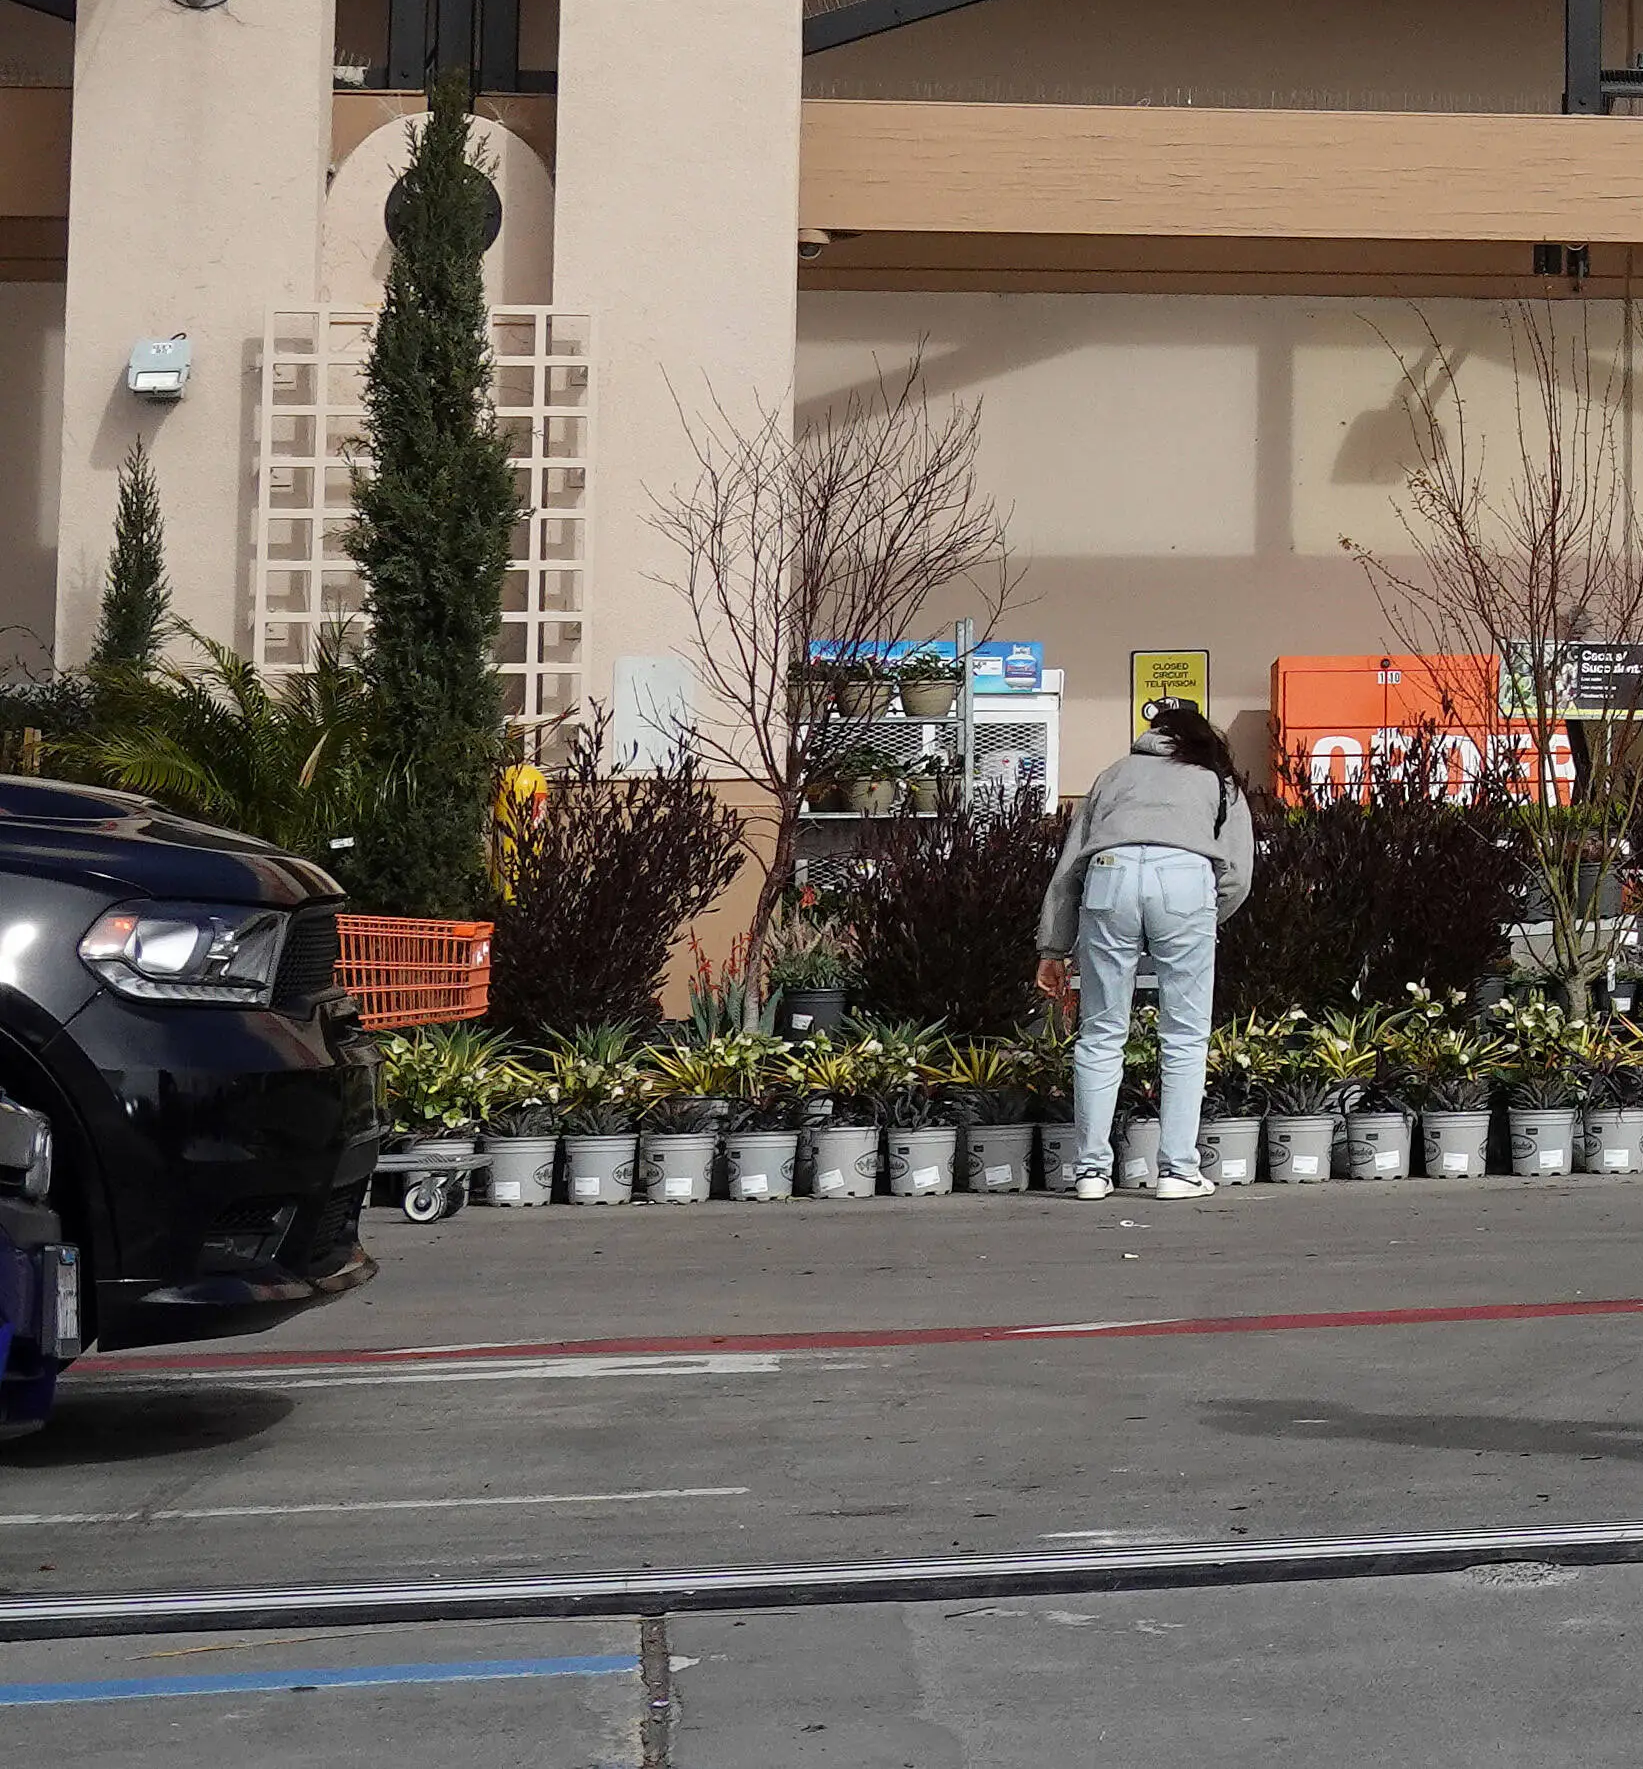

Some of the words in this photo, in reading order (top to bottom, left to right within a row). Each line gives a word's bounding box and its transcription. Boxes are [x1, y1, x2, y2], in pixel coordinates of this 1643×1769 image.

[1152, 662, 1189, 671] CLOSED
[1152, 671, 1189, 679] CIRCUIT
[1144, 679, 1197, 688] TELEVISION
